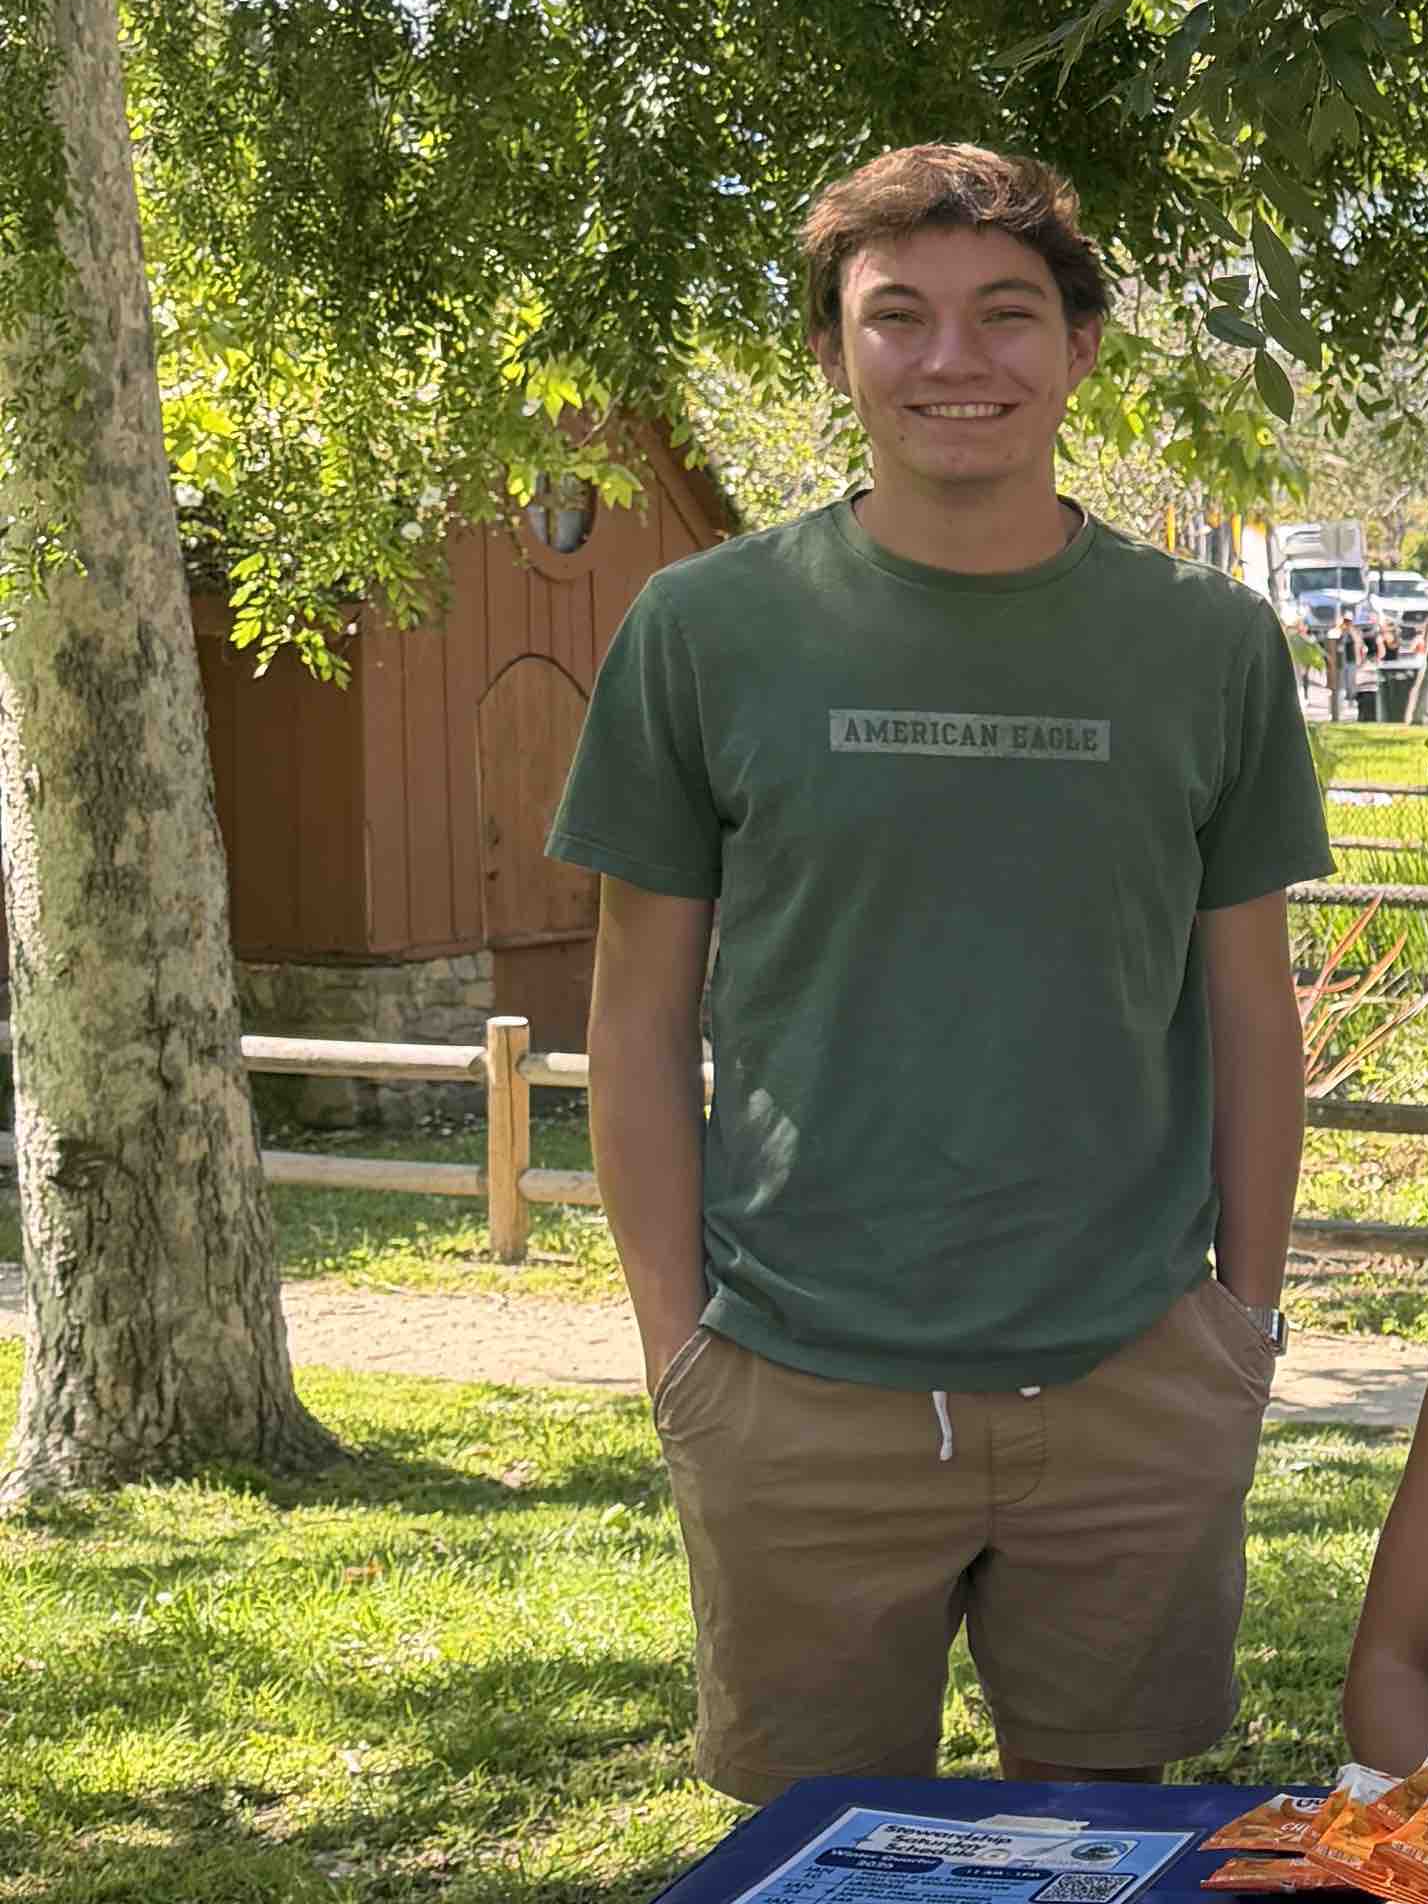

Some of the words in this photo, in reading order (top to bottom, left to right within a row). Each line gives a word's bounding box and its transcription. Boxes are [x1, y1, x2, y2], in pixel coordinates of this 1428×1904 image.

[844, 717, 999, 747] AMERICAN
[1011, 725, 1098, 752] EAGLE
[883, 1825, 1012, 1844] Stewardship
